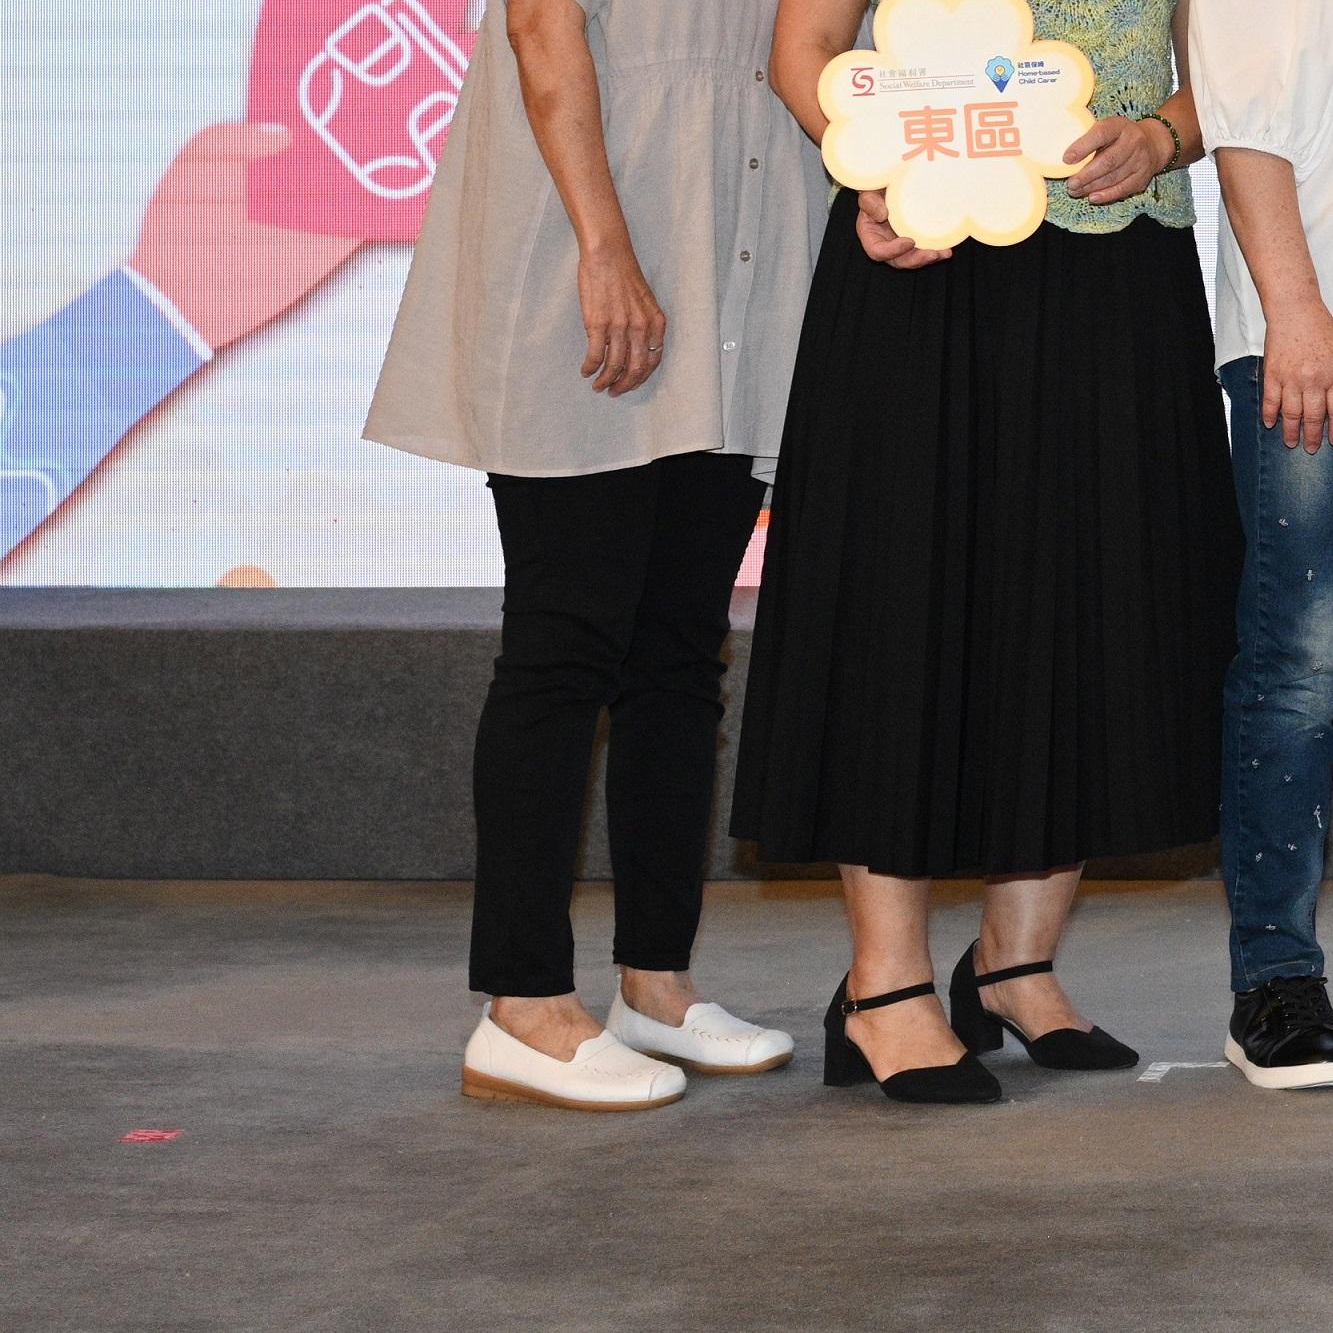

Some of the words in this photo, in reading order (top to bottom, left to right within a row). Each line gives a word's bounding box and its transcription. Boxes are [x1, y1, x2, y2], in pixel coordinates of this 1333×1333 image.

[879, 79, 901, 90] Social
[903, 79, 930, 89] Welfare
[931, 78, 974, 90] Department
[898, 101, 1023, 162] 東區
